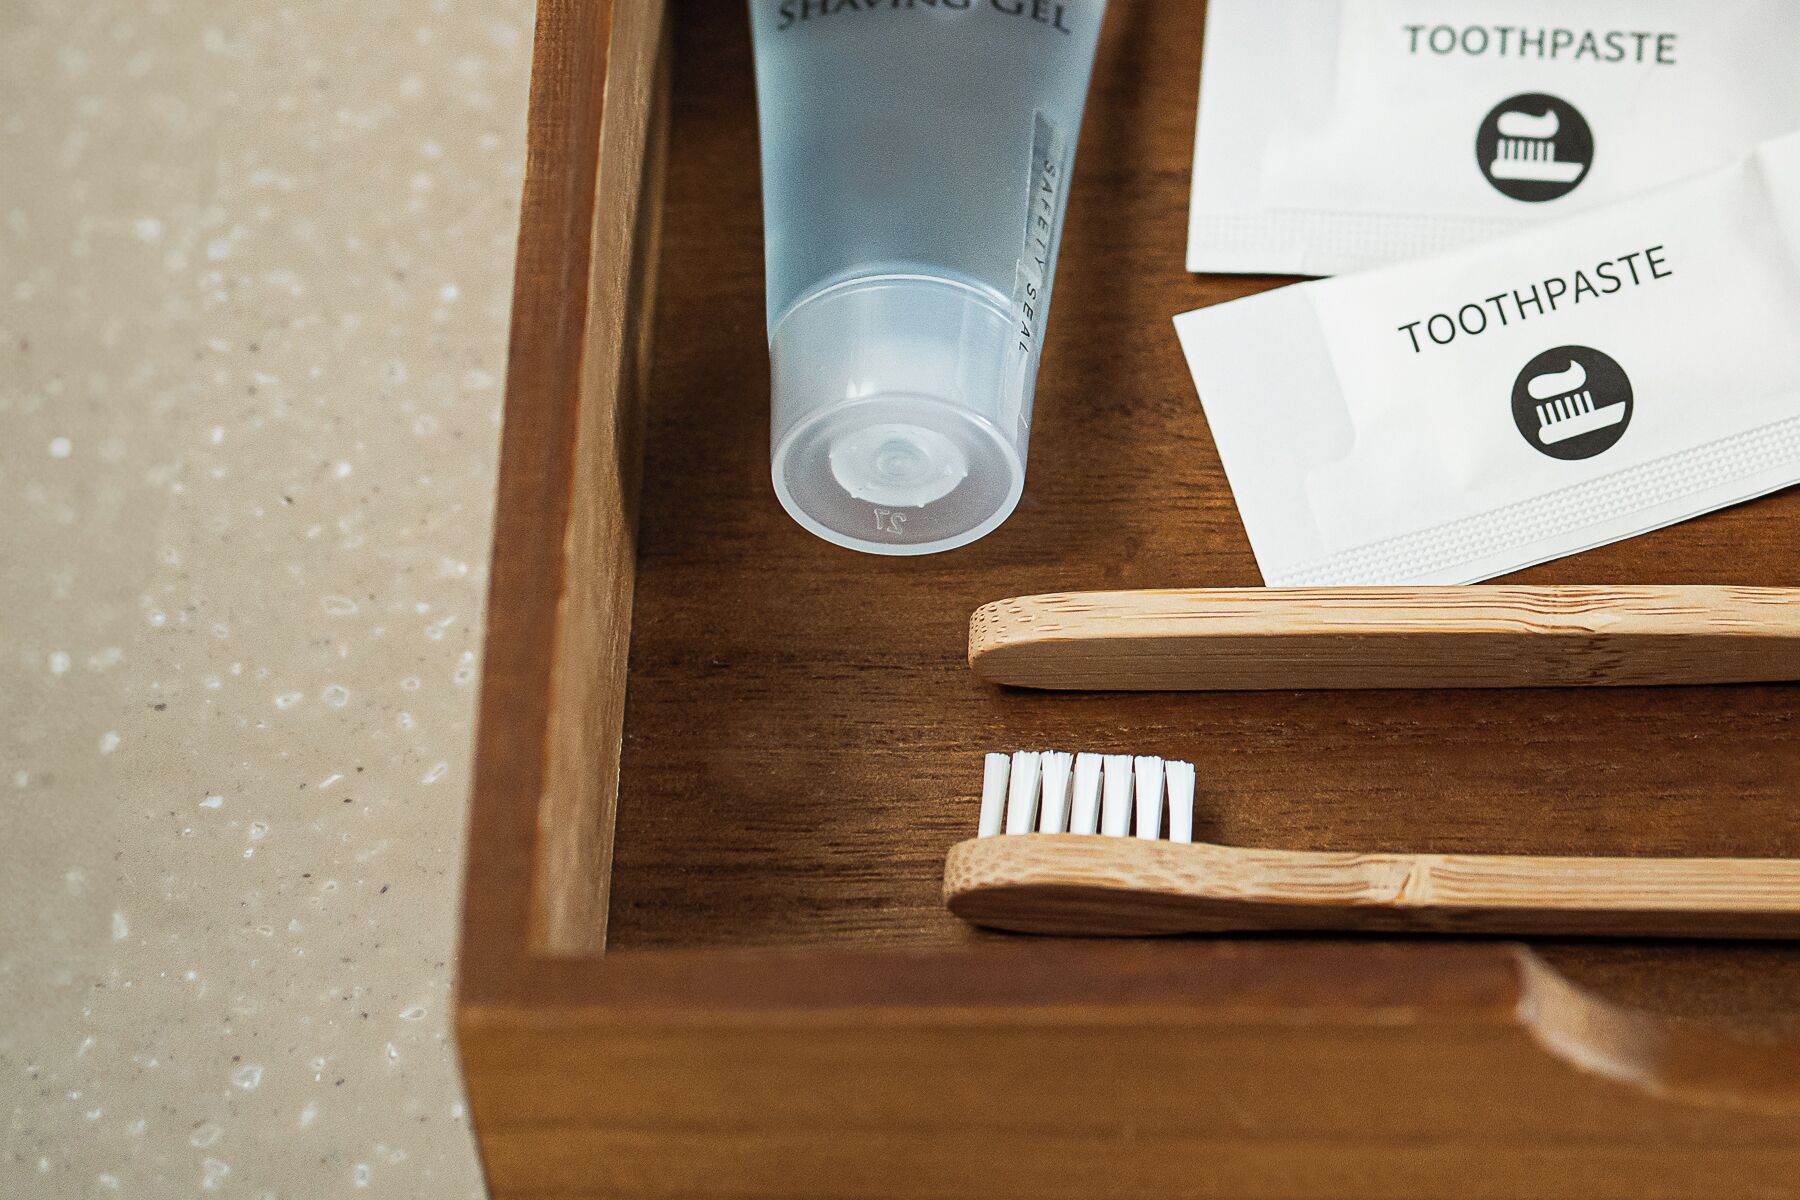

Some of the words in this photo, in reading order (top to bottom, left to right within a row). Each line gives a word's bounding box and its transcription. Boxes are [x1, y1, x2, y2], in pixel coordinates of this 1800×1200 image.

[1404, 24, 1678, 66] TOOTHPASTE
[1033, 158, 1056, 275] SAFETY
[1018, 281, 1038, 354] SEAL
[1397, 244, 1673, 355] TOOTHPASTE
